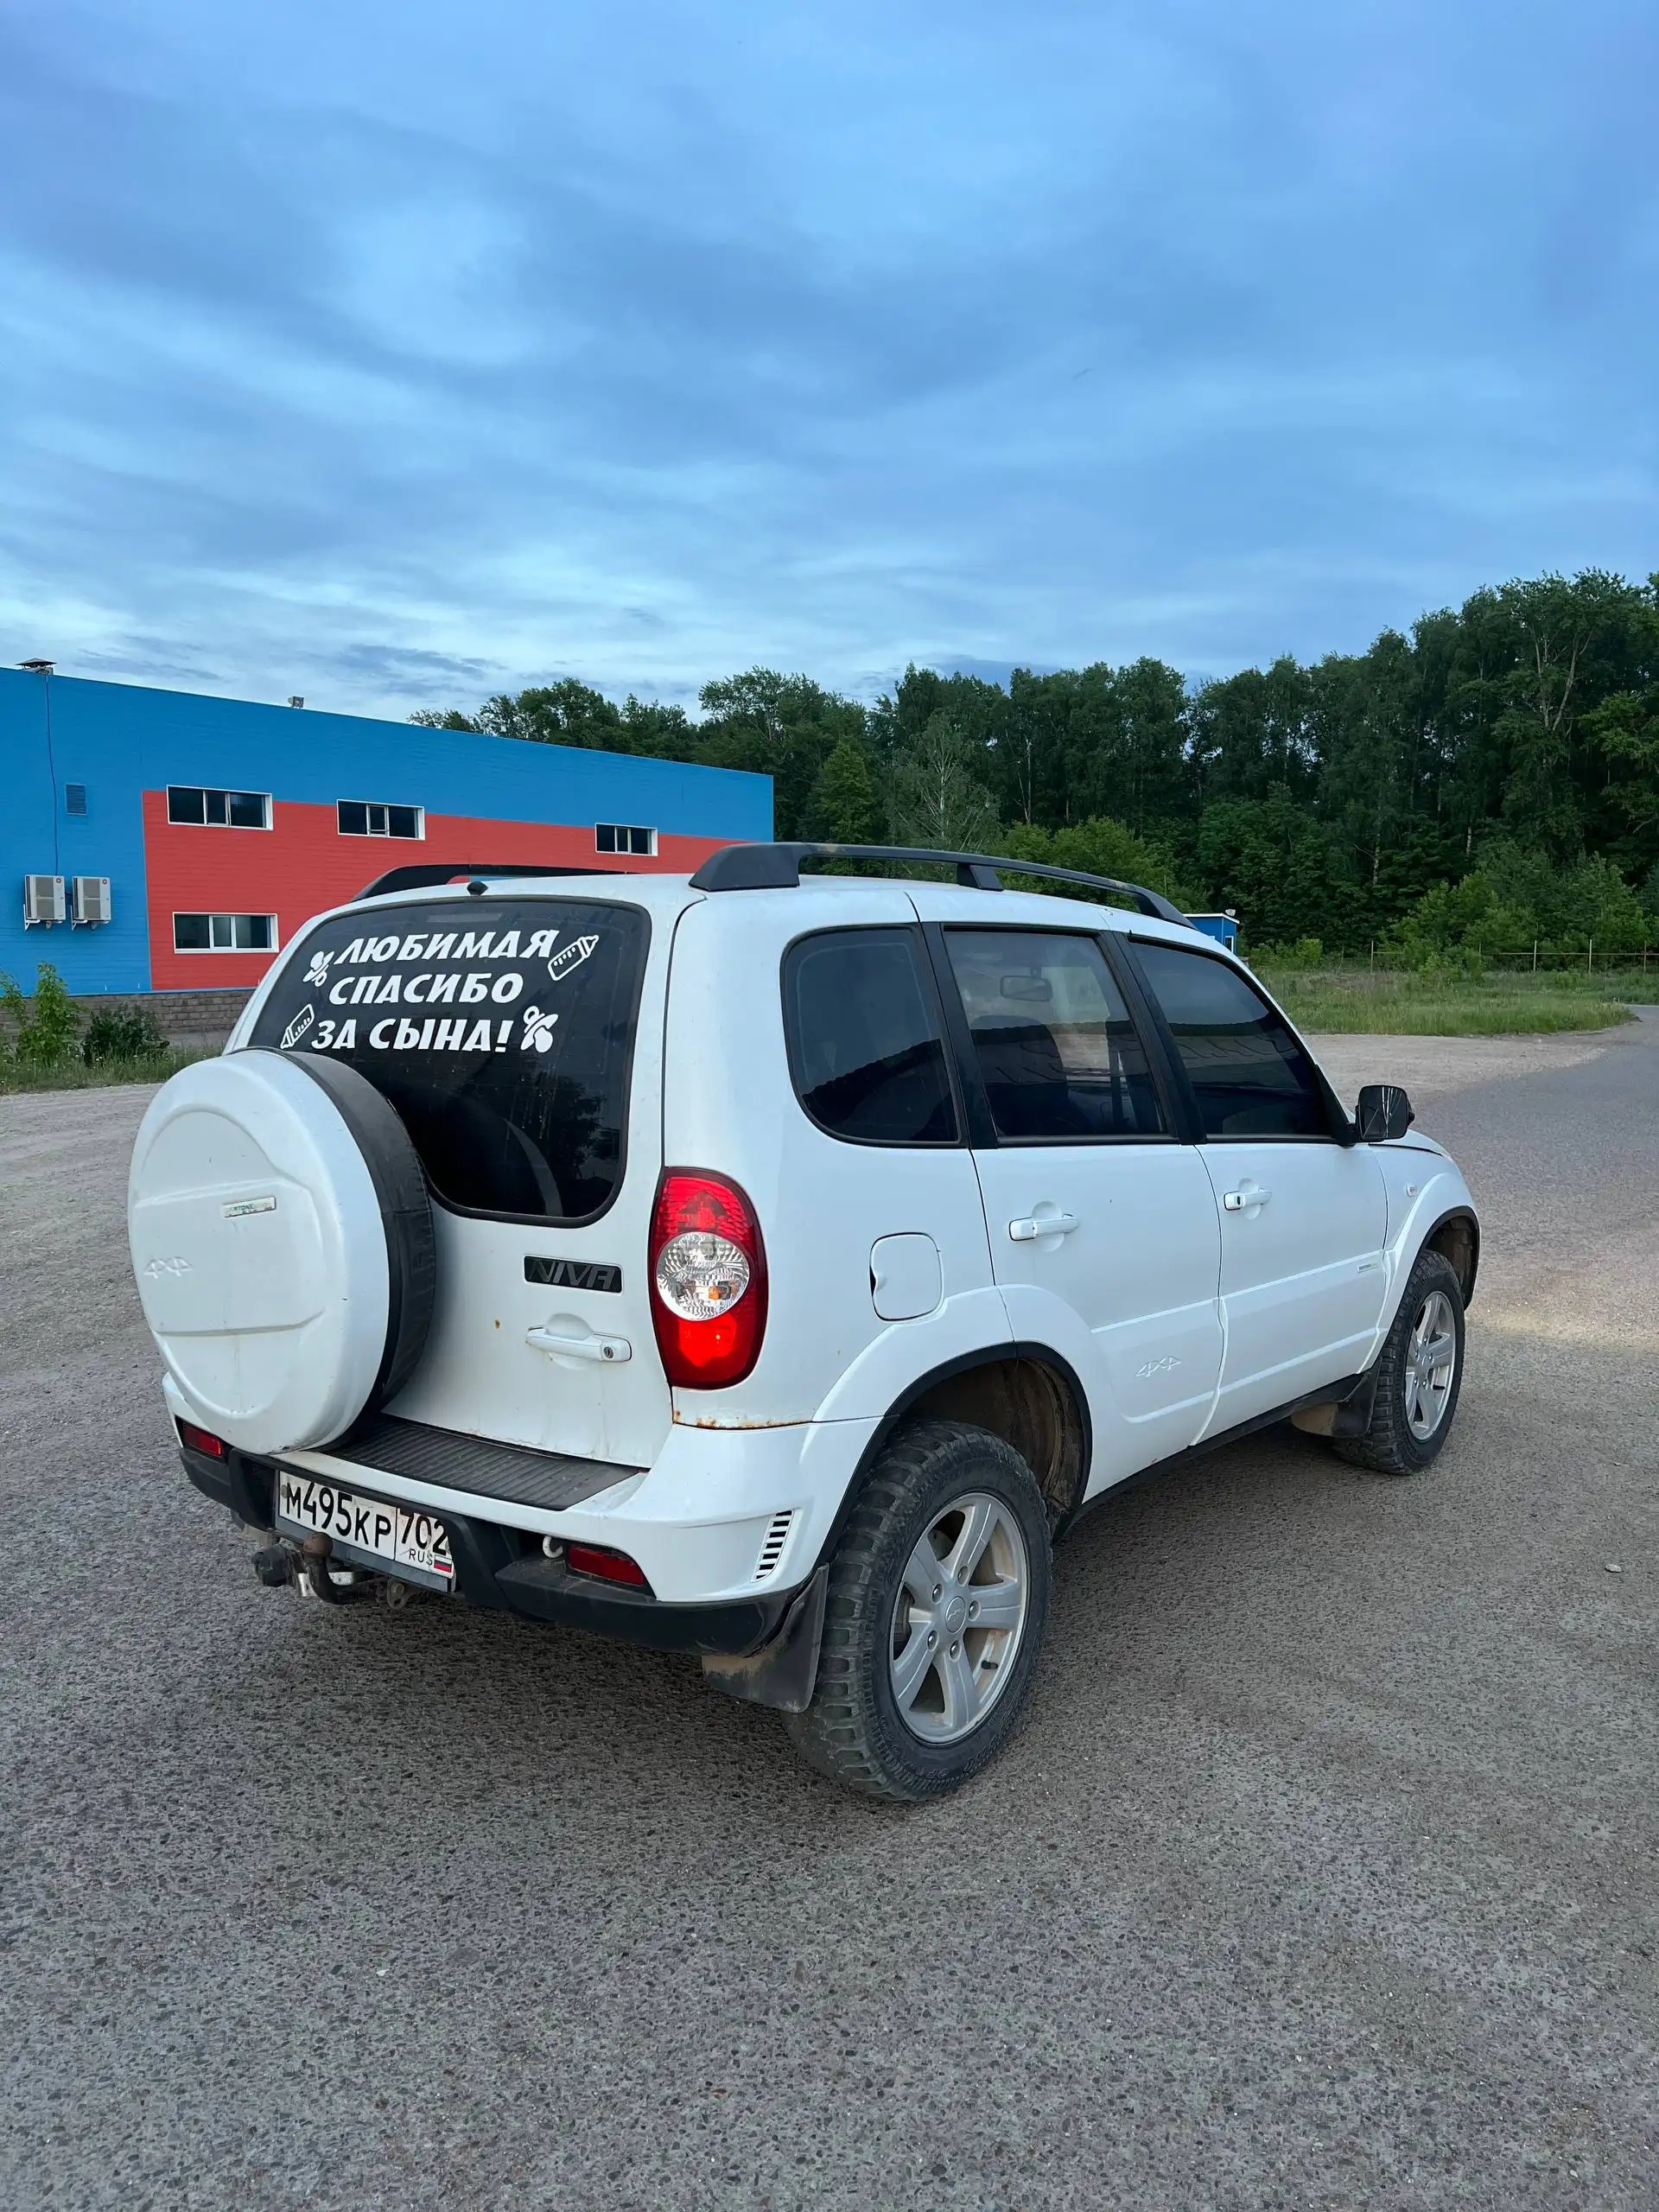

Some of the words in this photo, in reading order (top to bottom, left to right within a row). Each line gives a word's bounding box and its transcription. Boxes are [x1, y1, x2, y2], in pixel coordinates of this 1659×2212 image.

[334, 930, 559, 965] ЛЮБИМАЯ
[328, 973, 524, 1005] СПАСИБО
[311, 1019, 356, 1049] ЗА
[369, 1018, 514, 1053] СЫНА!
[528, 1259, 616, 1290] NIVA
[408, 1548, 434, 1566] RUS
